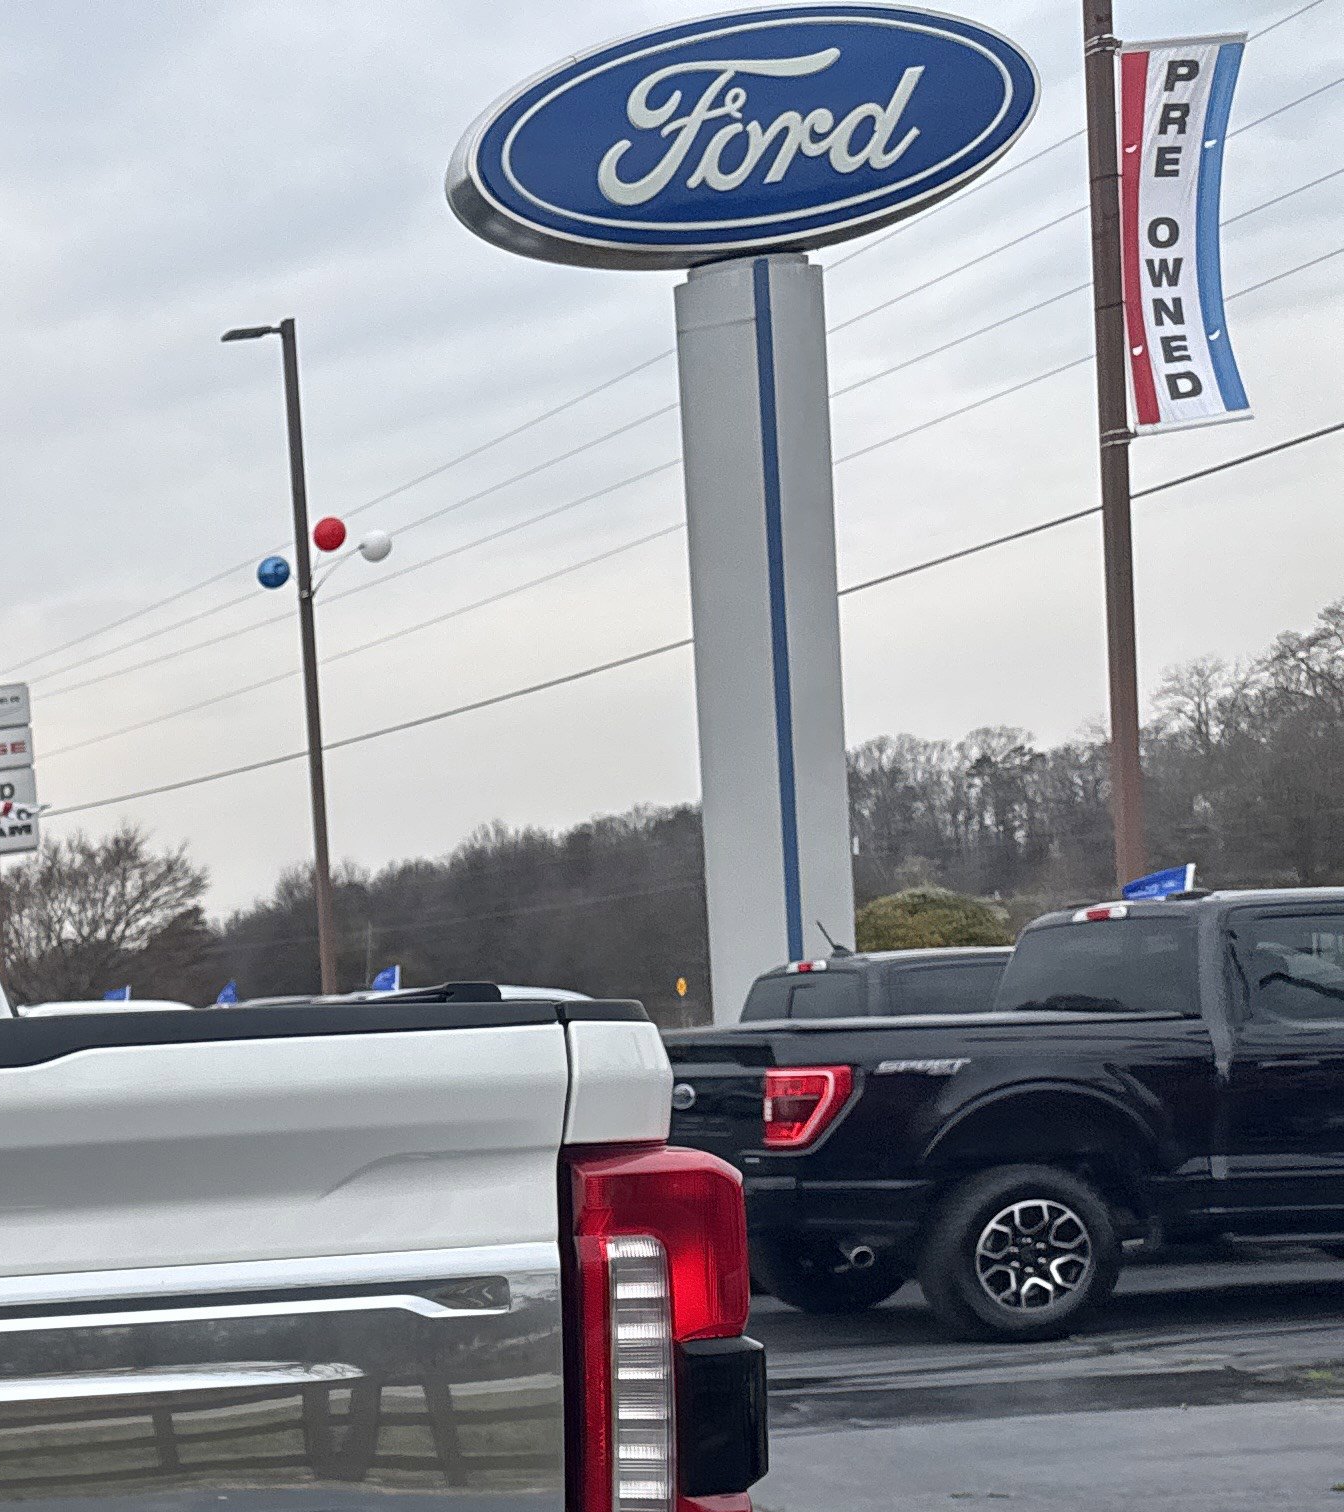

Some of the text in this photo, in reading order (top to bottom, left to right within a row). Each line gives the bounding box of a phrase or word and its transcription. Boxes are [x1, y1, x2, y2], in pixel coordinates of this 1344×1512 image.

[597, 47, 926, 206] Ford
[1144, 59, 1203, 401] PRE OWNED
